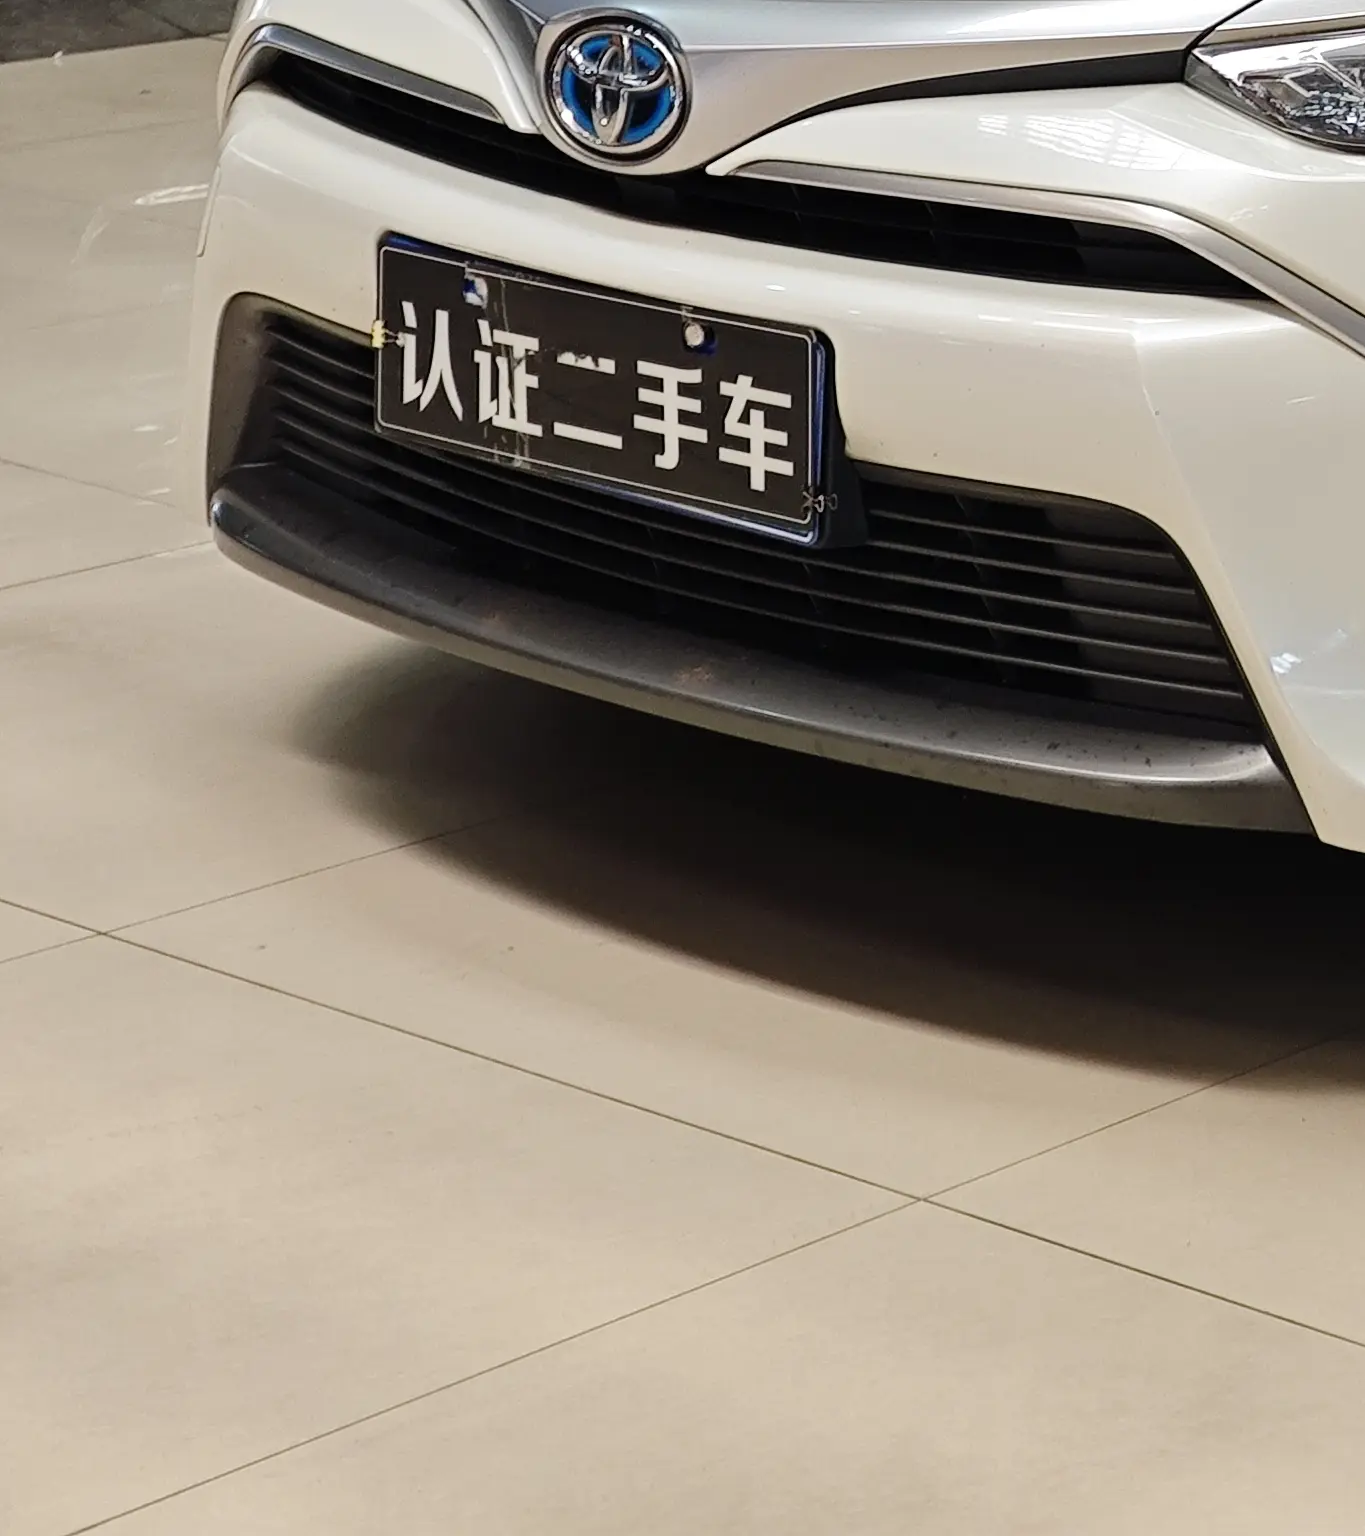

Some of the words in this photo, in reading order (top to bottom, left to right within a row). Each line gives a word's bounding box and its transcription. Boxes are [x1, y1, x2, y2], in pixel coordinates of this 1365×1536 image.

[401, 300, 795, 492] 认证二手车
